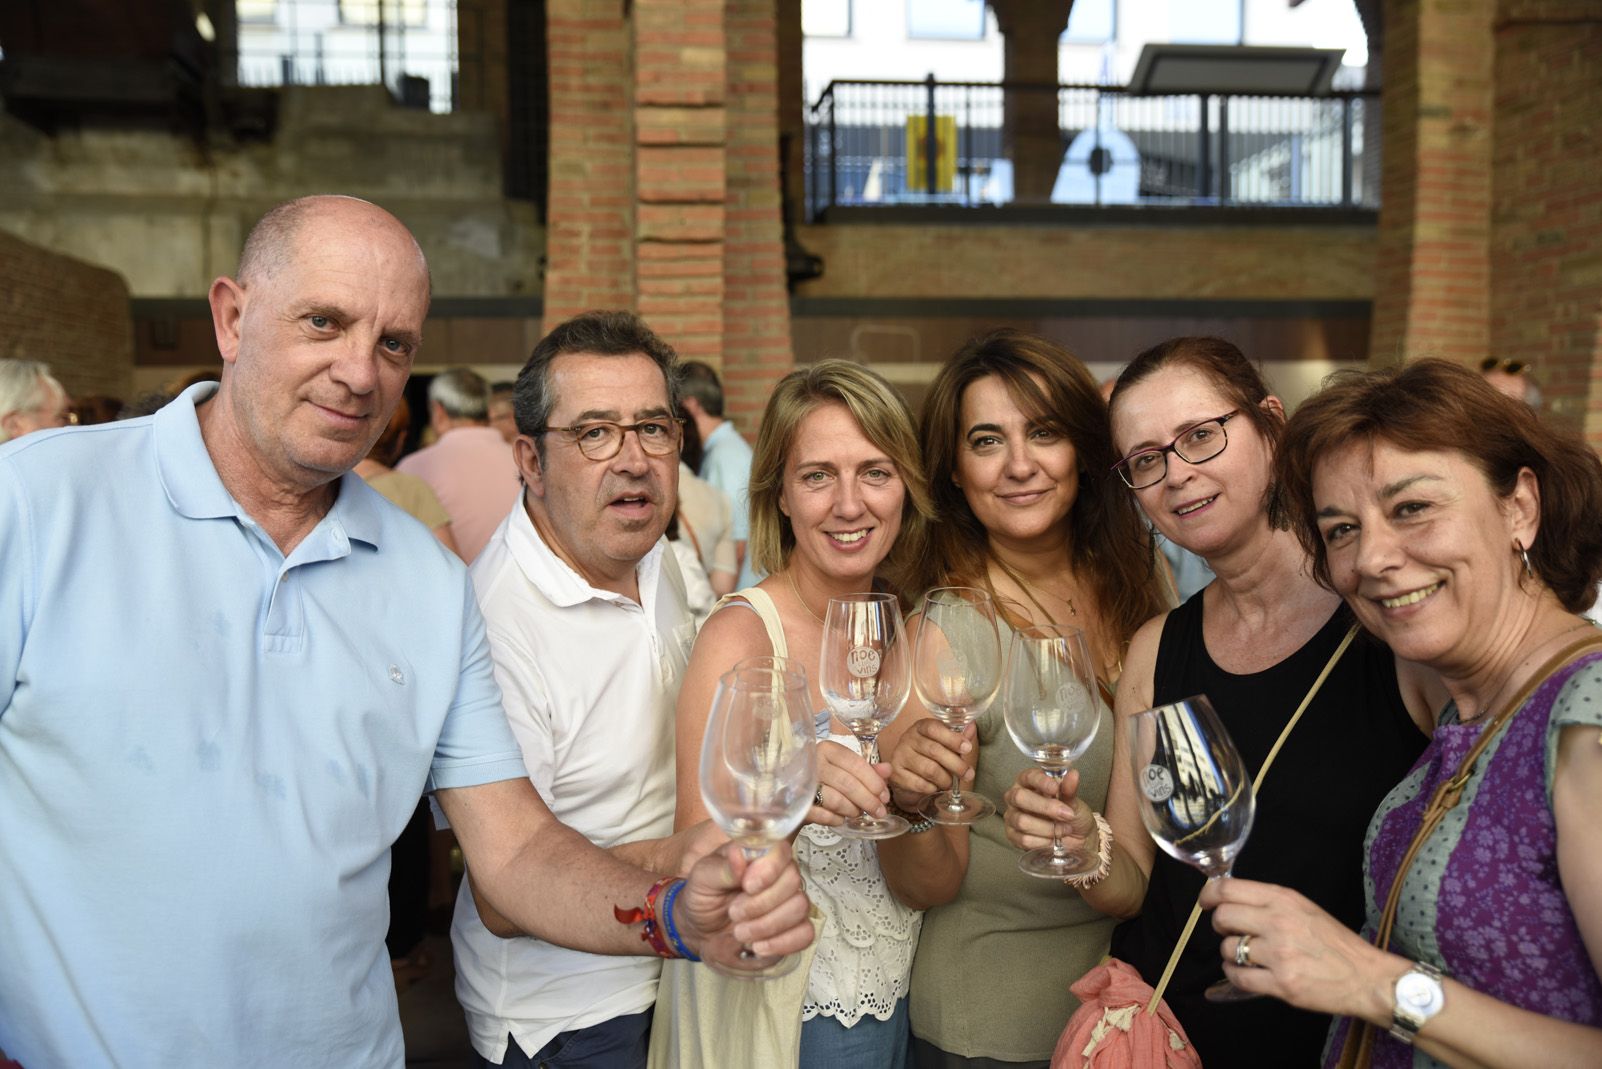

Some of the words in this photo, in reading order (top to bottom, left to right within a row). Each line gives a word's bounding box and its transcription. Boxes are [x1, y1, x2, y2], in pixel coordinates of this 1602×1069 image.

[851, 650, 876, 664] noe
[857, 664, 878, 674] vins
[1150, 783, 1172, 798] vins
